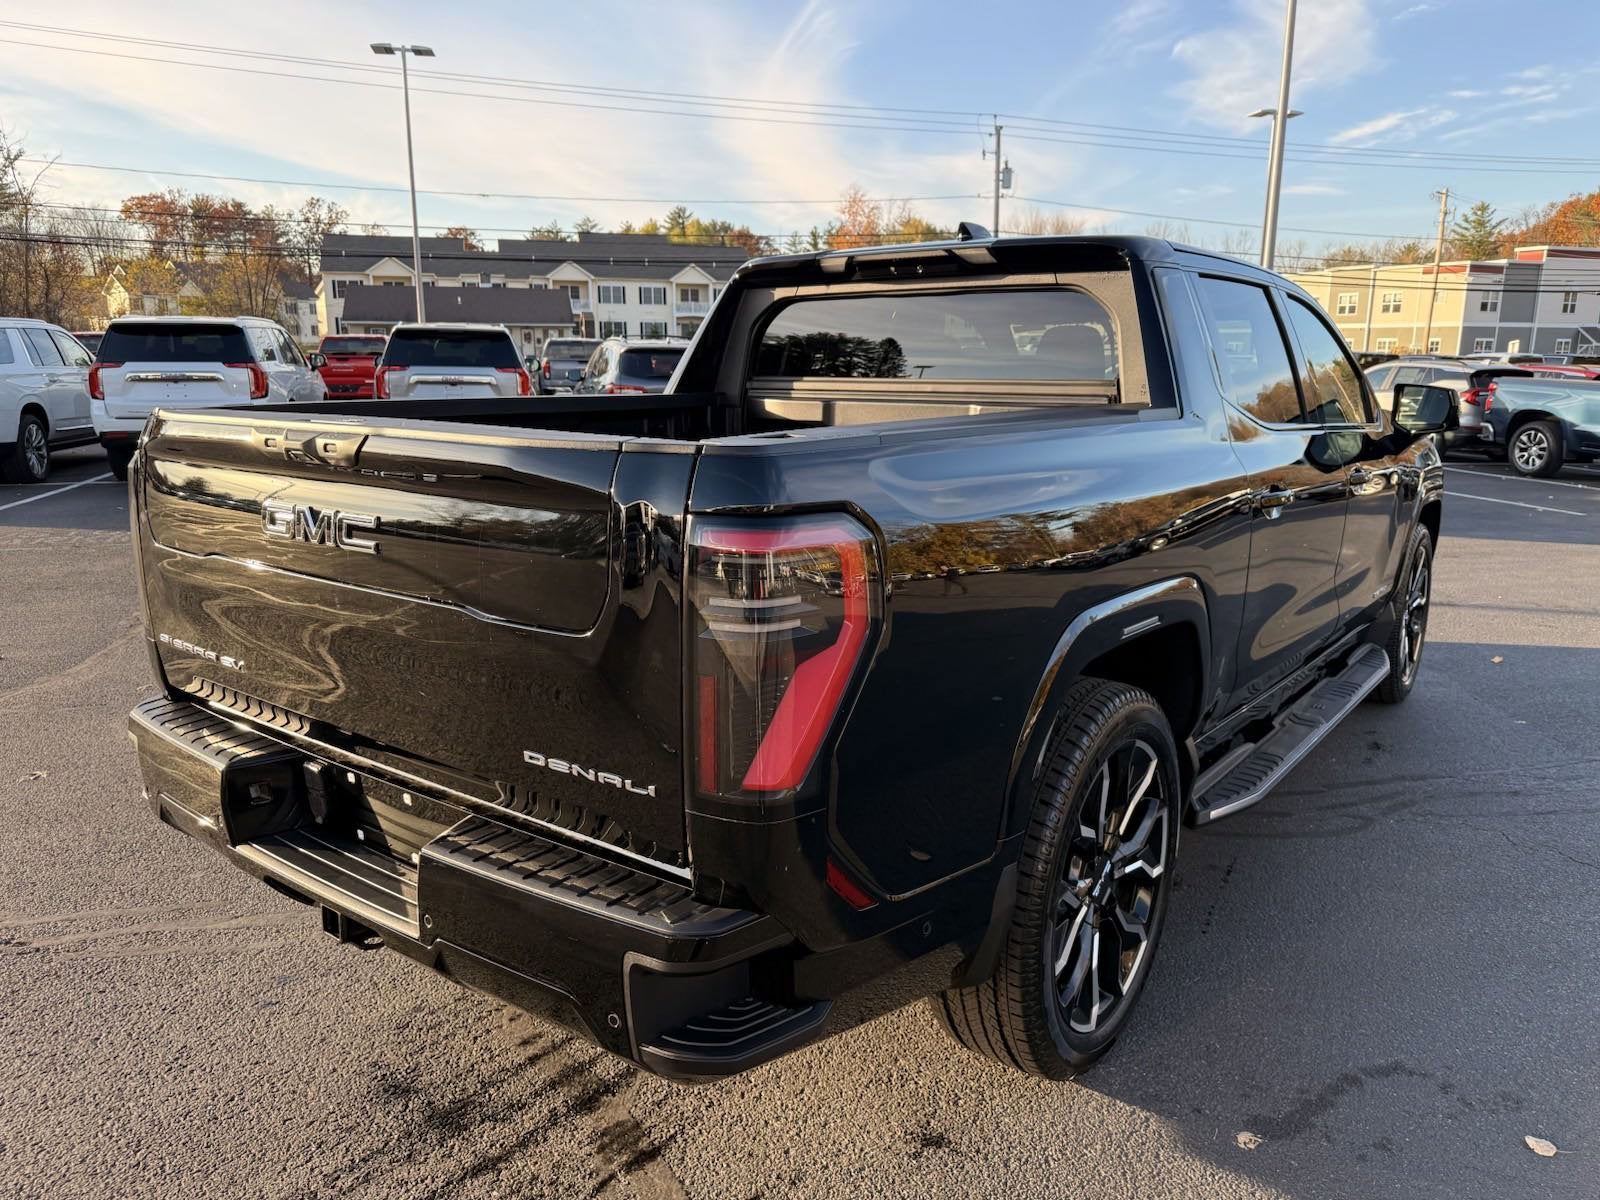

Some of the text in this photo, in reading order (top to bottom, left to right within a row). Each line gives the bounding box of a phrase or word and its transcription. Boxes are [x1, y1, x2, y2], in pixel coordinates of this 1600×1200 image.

[261, 498, 380, 554] GMC
[160, 633, 246, 673] SIERRA EV
[523, 750, 656, 798] DENALI
